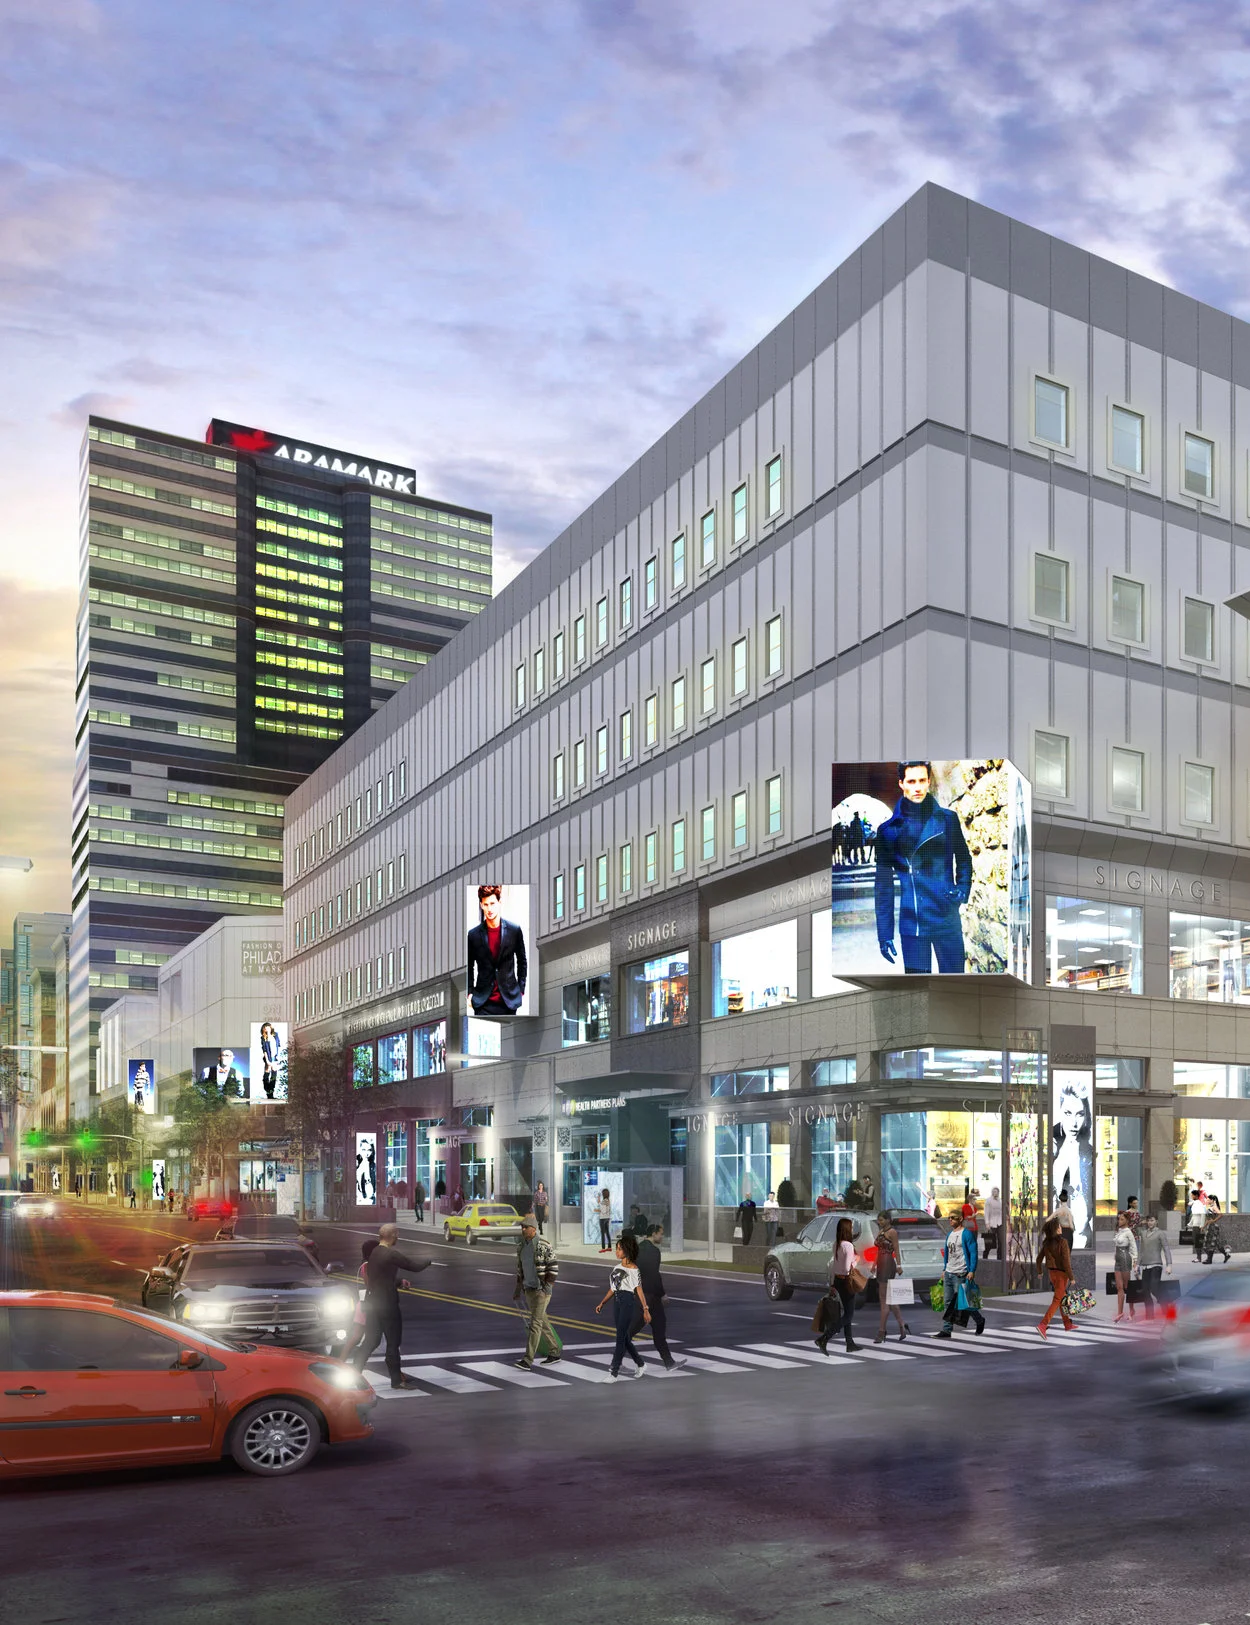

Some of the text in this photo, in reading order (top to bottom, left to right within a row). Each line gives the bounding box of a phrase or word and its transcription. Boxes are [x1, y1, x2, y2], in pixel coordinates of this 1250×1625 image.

[274, 444, 415, 494] ARAMARK
[1095, 865, 1223, 903] SIGNAGE
[627, 920, 677, 951] SIGNAGE
[591, 1098, 611, 1110] PARTNERS
[612, 1096, 627, 1108] PLANS
[788, 1101, 864, 1127] SIGNAGE
